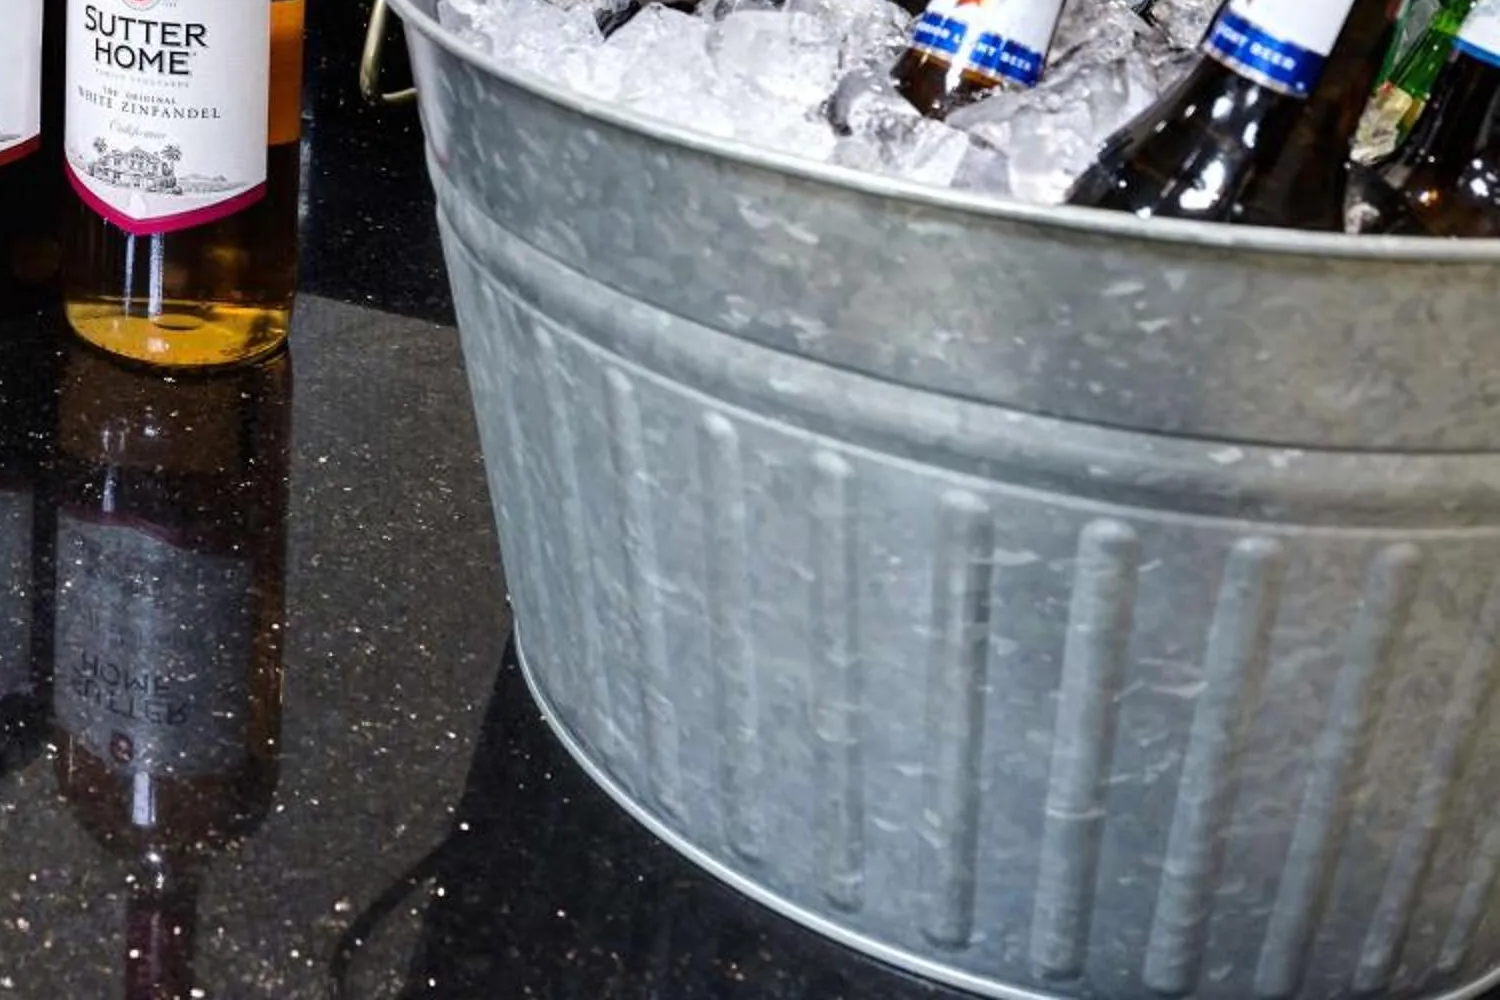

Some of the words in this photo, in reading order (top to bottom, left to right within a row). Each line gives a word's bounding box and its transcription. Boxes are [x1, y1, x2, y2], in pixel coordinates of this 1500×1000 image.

[84, 4, 210, 49] SUTTER
[94, 37, 191, 76] HOME
[77, 84, 113, 110] WHITE
[120, 101, 222, 120] ZINFANDEL
